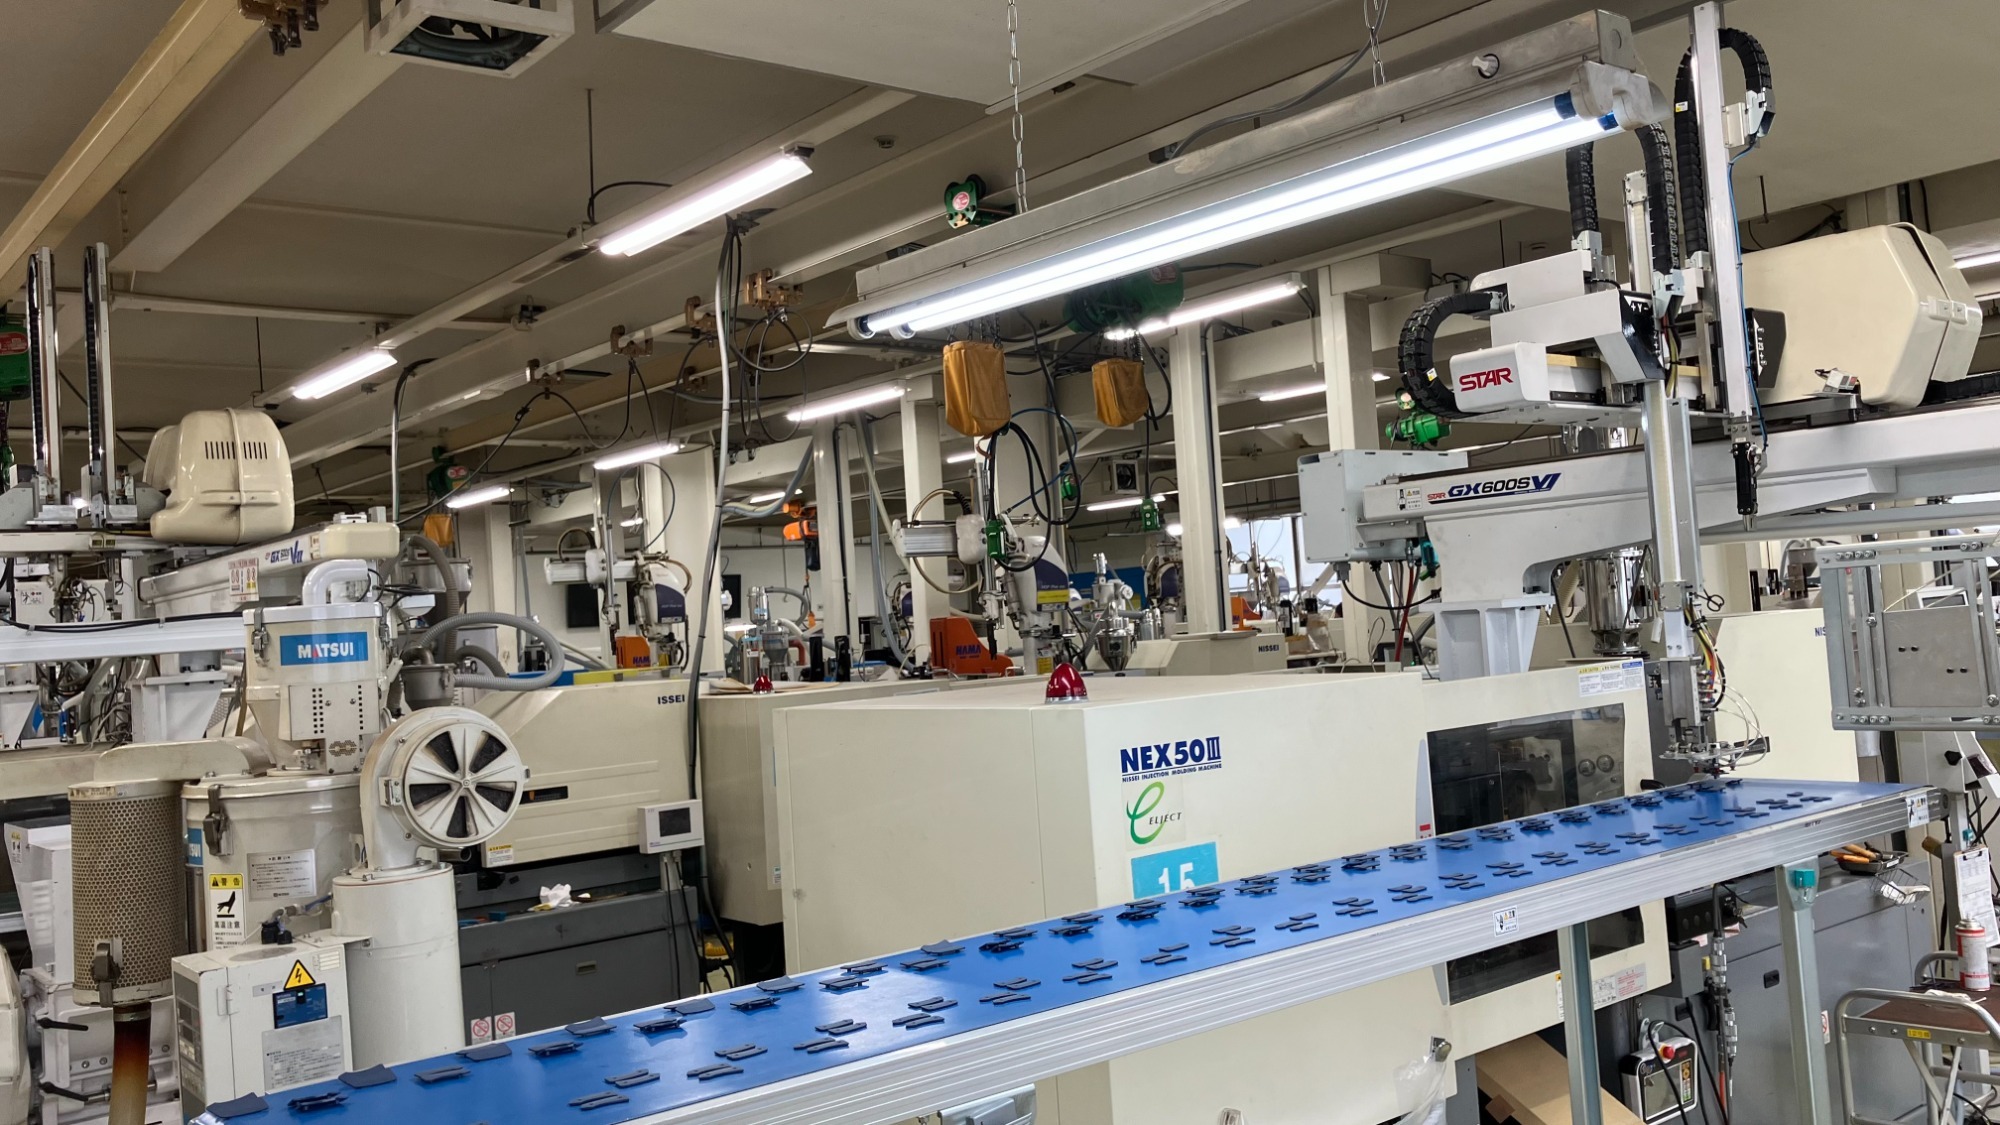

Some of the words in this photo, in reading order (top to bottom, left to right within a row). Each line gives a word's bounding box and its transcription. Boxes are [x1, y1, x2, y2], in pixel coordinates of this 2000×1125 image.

[1459, 367, 1513, 392] STAR
[1427, 492, 1446, 500] STAR
[297, 642, 354, 659] MATSUI
[956, 644, 982, 655] HAMA
[1258, 644, 1280, 653] NISSEI
[657, 694, 685, 705] ISSEI
[1122, 775, 1140, 783] NISSEI
[1141, 771, 1169, 780] INJECTION
[1171, 766, 1197, 775] MOLDING
[1198, 763, 1222, 772] MACHINE
[1158, 862, 1195, 893] 15
